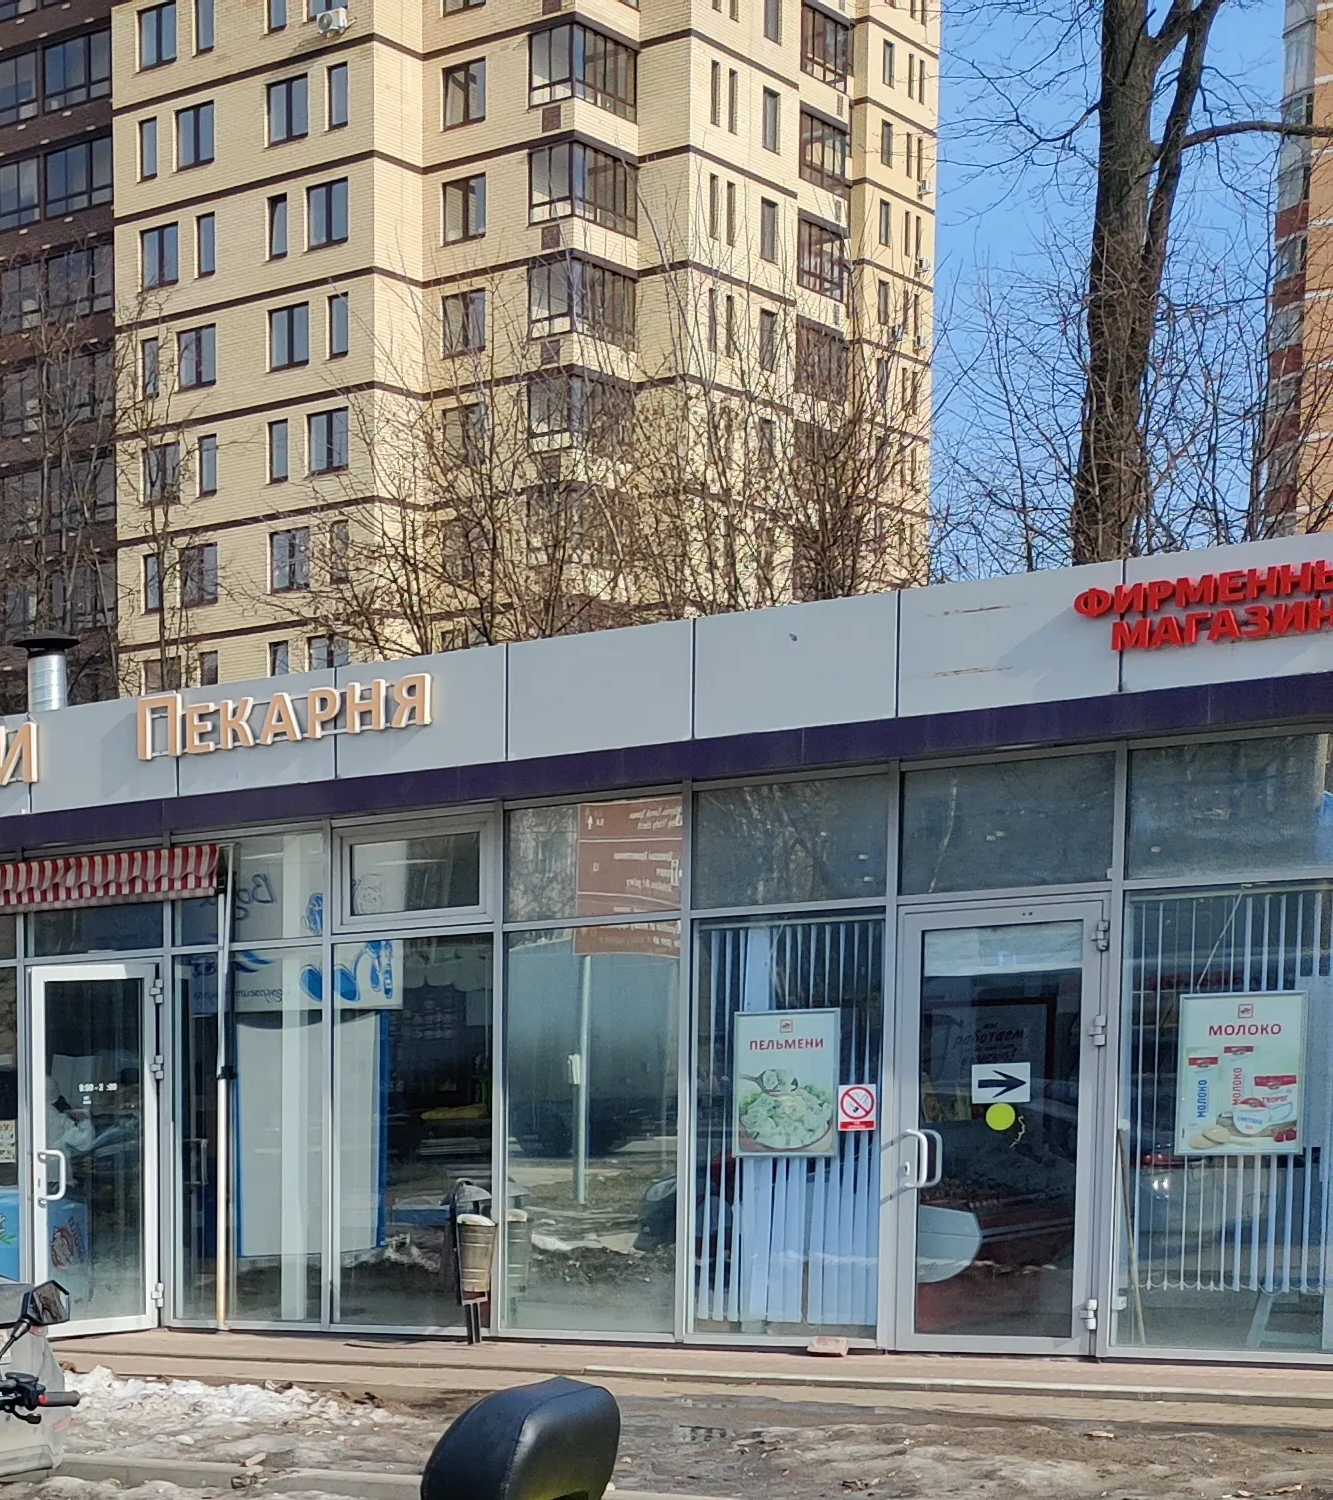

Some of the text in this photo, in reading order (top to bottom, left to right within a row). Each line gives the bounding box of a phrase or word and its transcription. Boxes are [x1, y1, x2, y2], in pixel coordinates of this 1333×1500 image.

[1111, 599, 1333, 651] МАГАЗИН
[138, 673, 432, 760] ПЕКАРНЯ
[749, 1038, 824, 1051] ПЕЛЬМЕНИ
[1209, 1023, 1282, 1036] МОЛОКО
[1197, 1079, 1208, 1118] МОЛОКО
